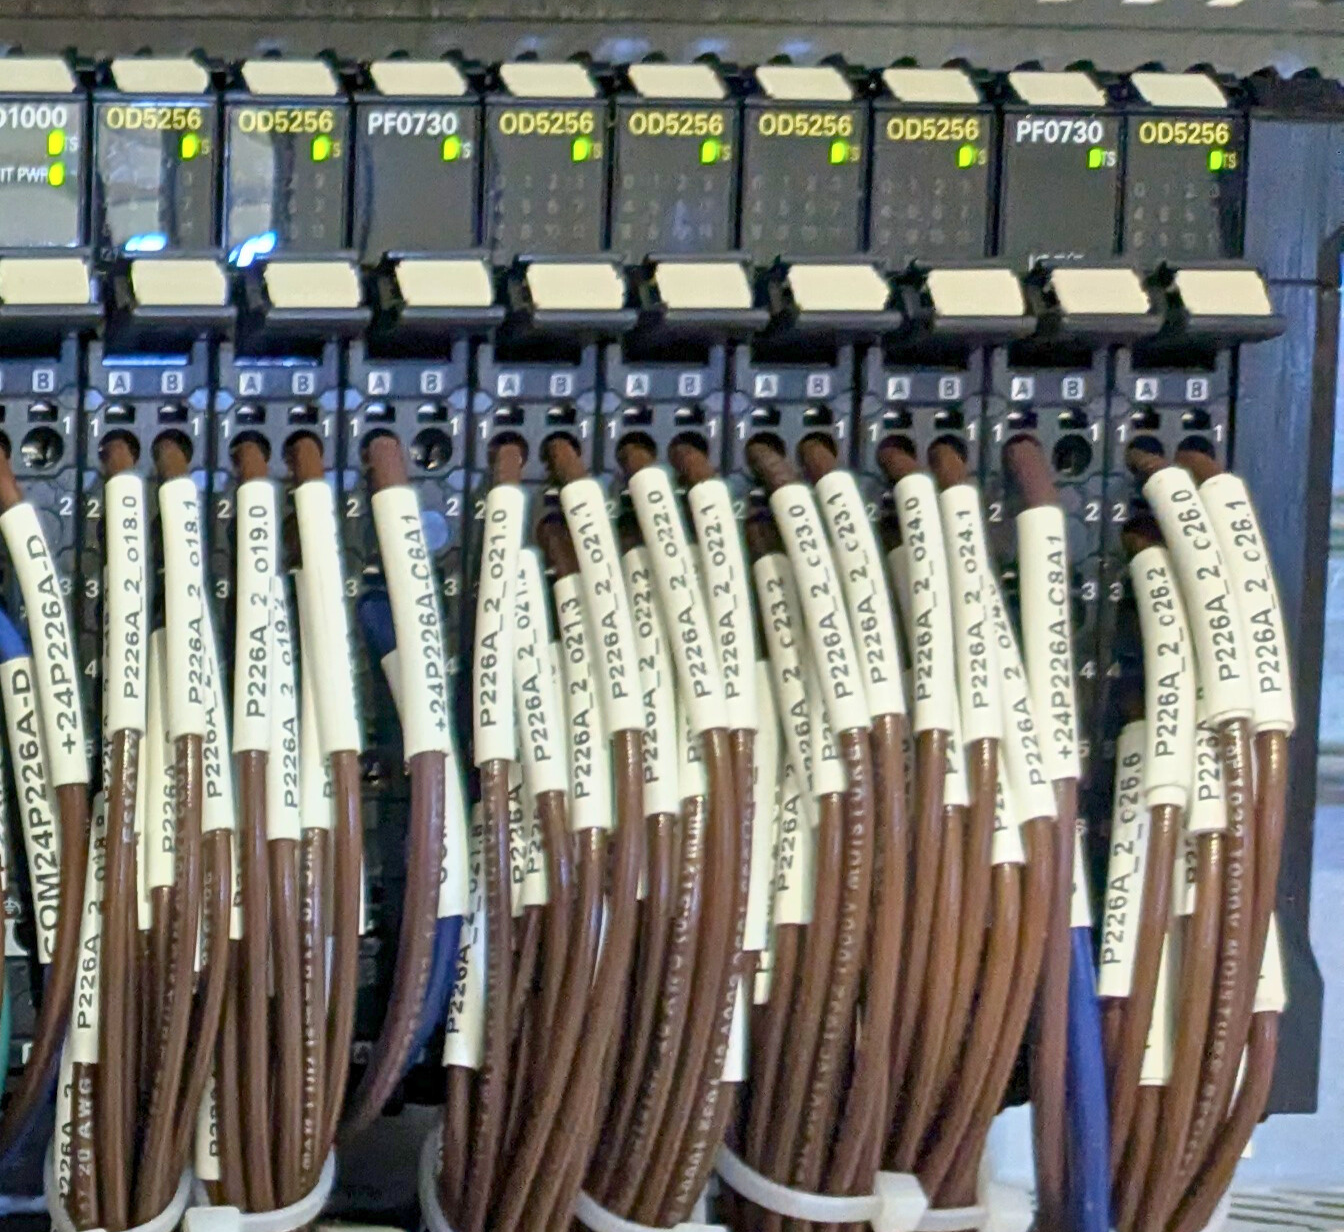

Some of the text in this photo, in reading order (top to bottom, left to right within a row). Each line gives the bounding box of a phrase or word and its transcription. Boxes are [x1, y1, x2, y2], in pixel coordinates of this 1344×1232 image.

[106, 106, 202, 130] OD5256
[238, 108, 334, 132] OD5256
[367, 111, 457, 135] PF0730
[499, 111, 594, 136] OD5256
[628, 112, 724, 136] OD5256
[758, 113, 853, 137] OD5256
[885, 117, 980, 141] OD5256
[1015, 119, 1104, 143] PF0730
[1138, 121, 1231, 144] OD5256
[26, 535, 78, 754] +24P226A-D
[122, 496, 143, 700] P226A_2_o18.0
[246, 505, 272, 718] P226A_2_o19.0
[479, 509, 508, 728] P226A_2_o21.0
[568, 501, 628, 699] P226A_2_o21.1
[646, 490, 711, 698] P226A_2_o22.0
[702, 503, 740, 699] P226A_2_o22.1
[905, 497, 936, 700] P226A_2_o24.0
[955, 509, 988, 708] P226A_2_o24.1
